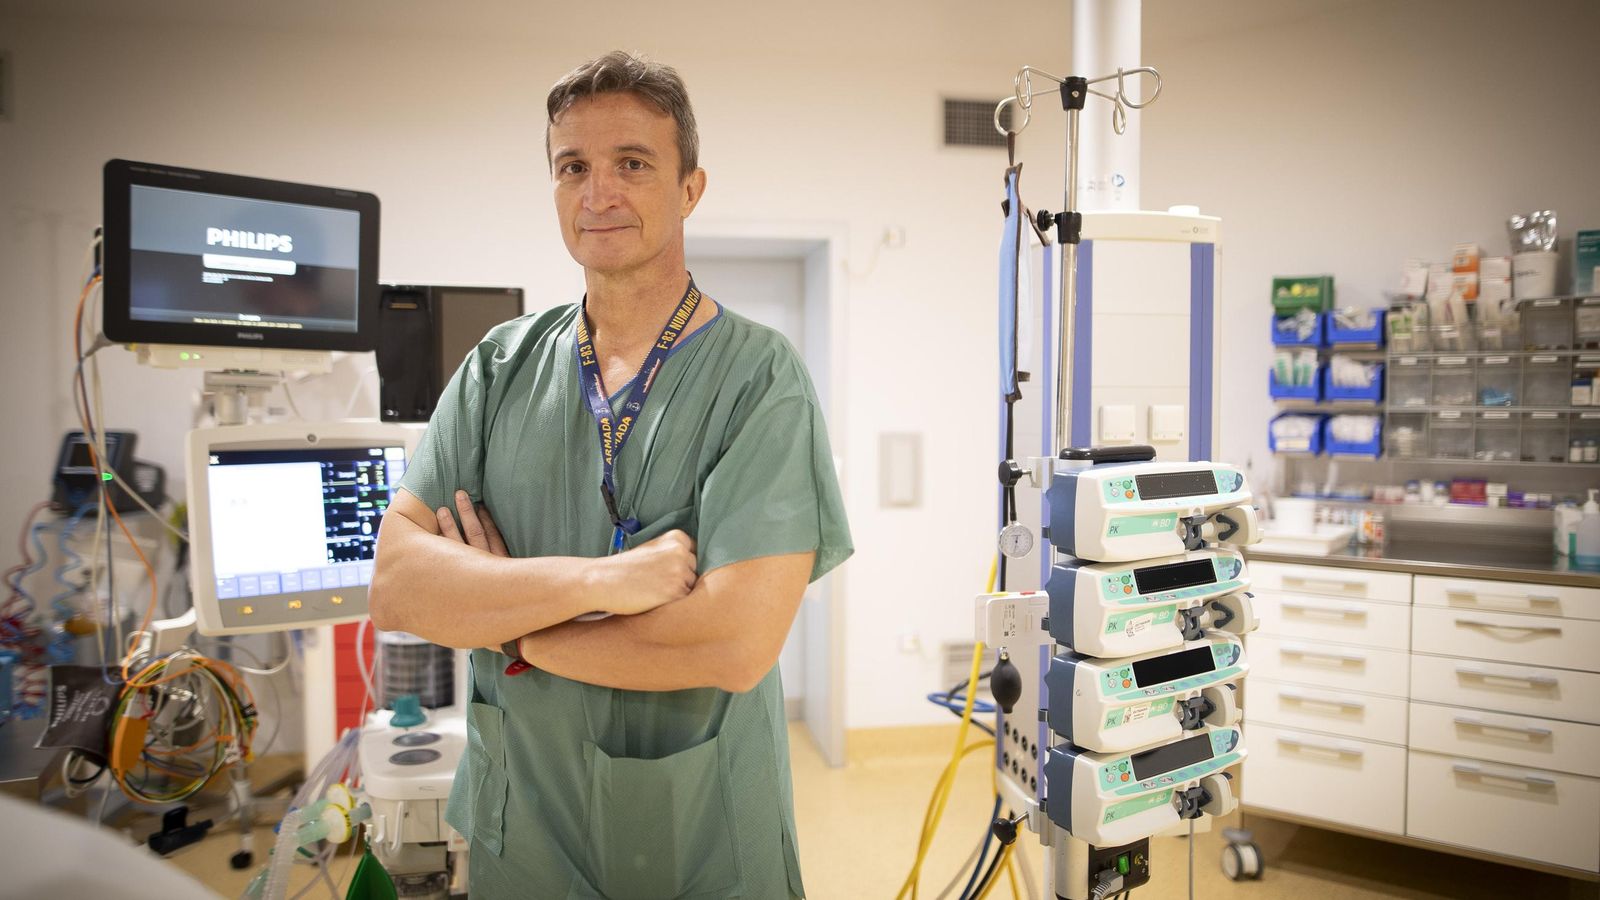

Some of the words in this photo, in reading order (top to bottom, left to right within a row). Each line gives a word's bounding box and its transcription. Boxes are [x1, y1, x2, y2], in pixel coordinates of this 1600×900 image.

[206, 227, 294, 253] PHILIPS
[656, 330, 676, 350] F-83
[669, 287, 700, 331] NUMANCIA
[580, 344, 596, 366] F-83
[600, 417, 612, 465] ARMADA
[1159, 518, 1171, 528] BD
[1109, 525, 1120, 535] PK
[1107, 622, 1118, 631] PK
[1106, 716, 1117, 726] PK
[1105, 811, 1115, 821] PK
